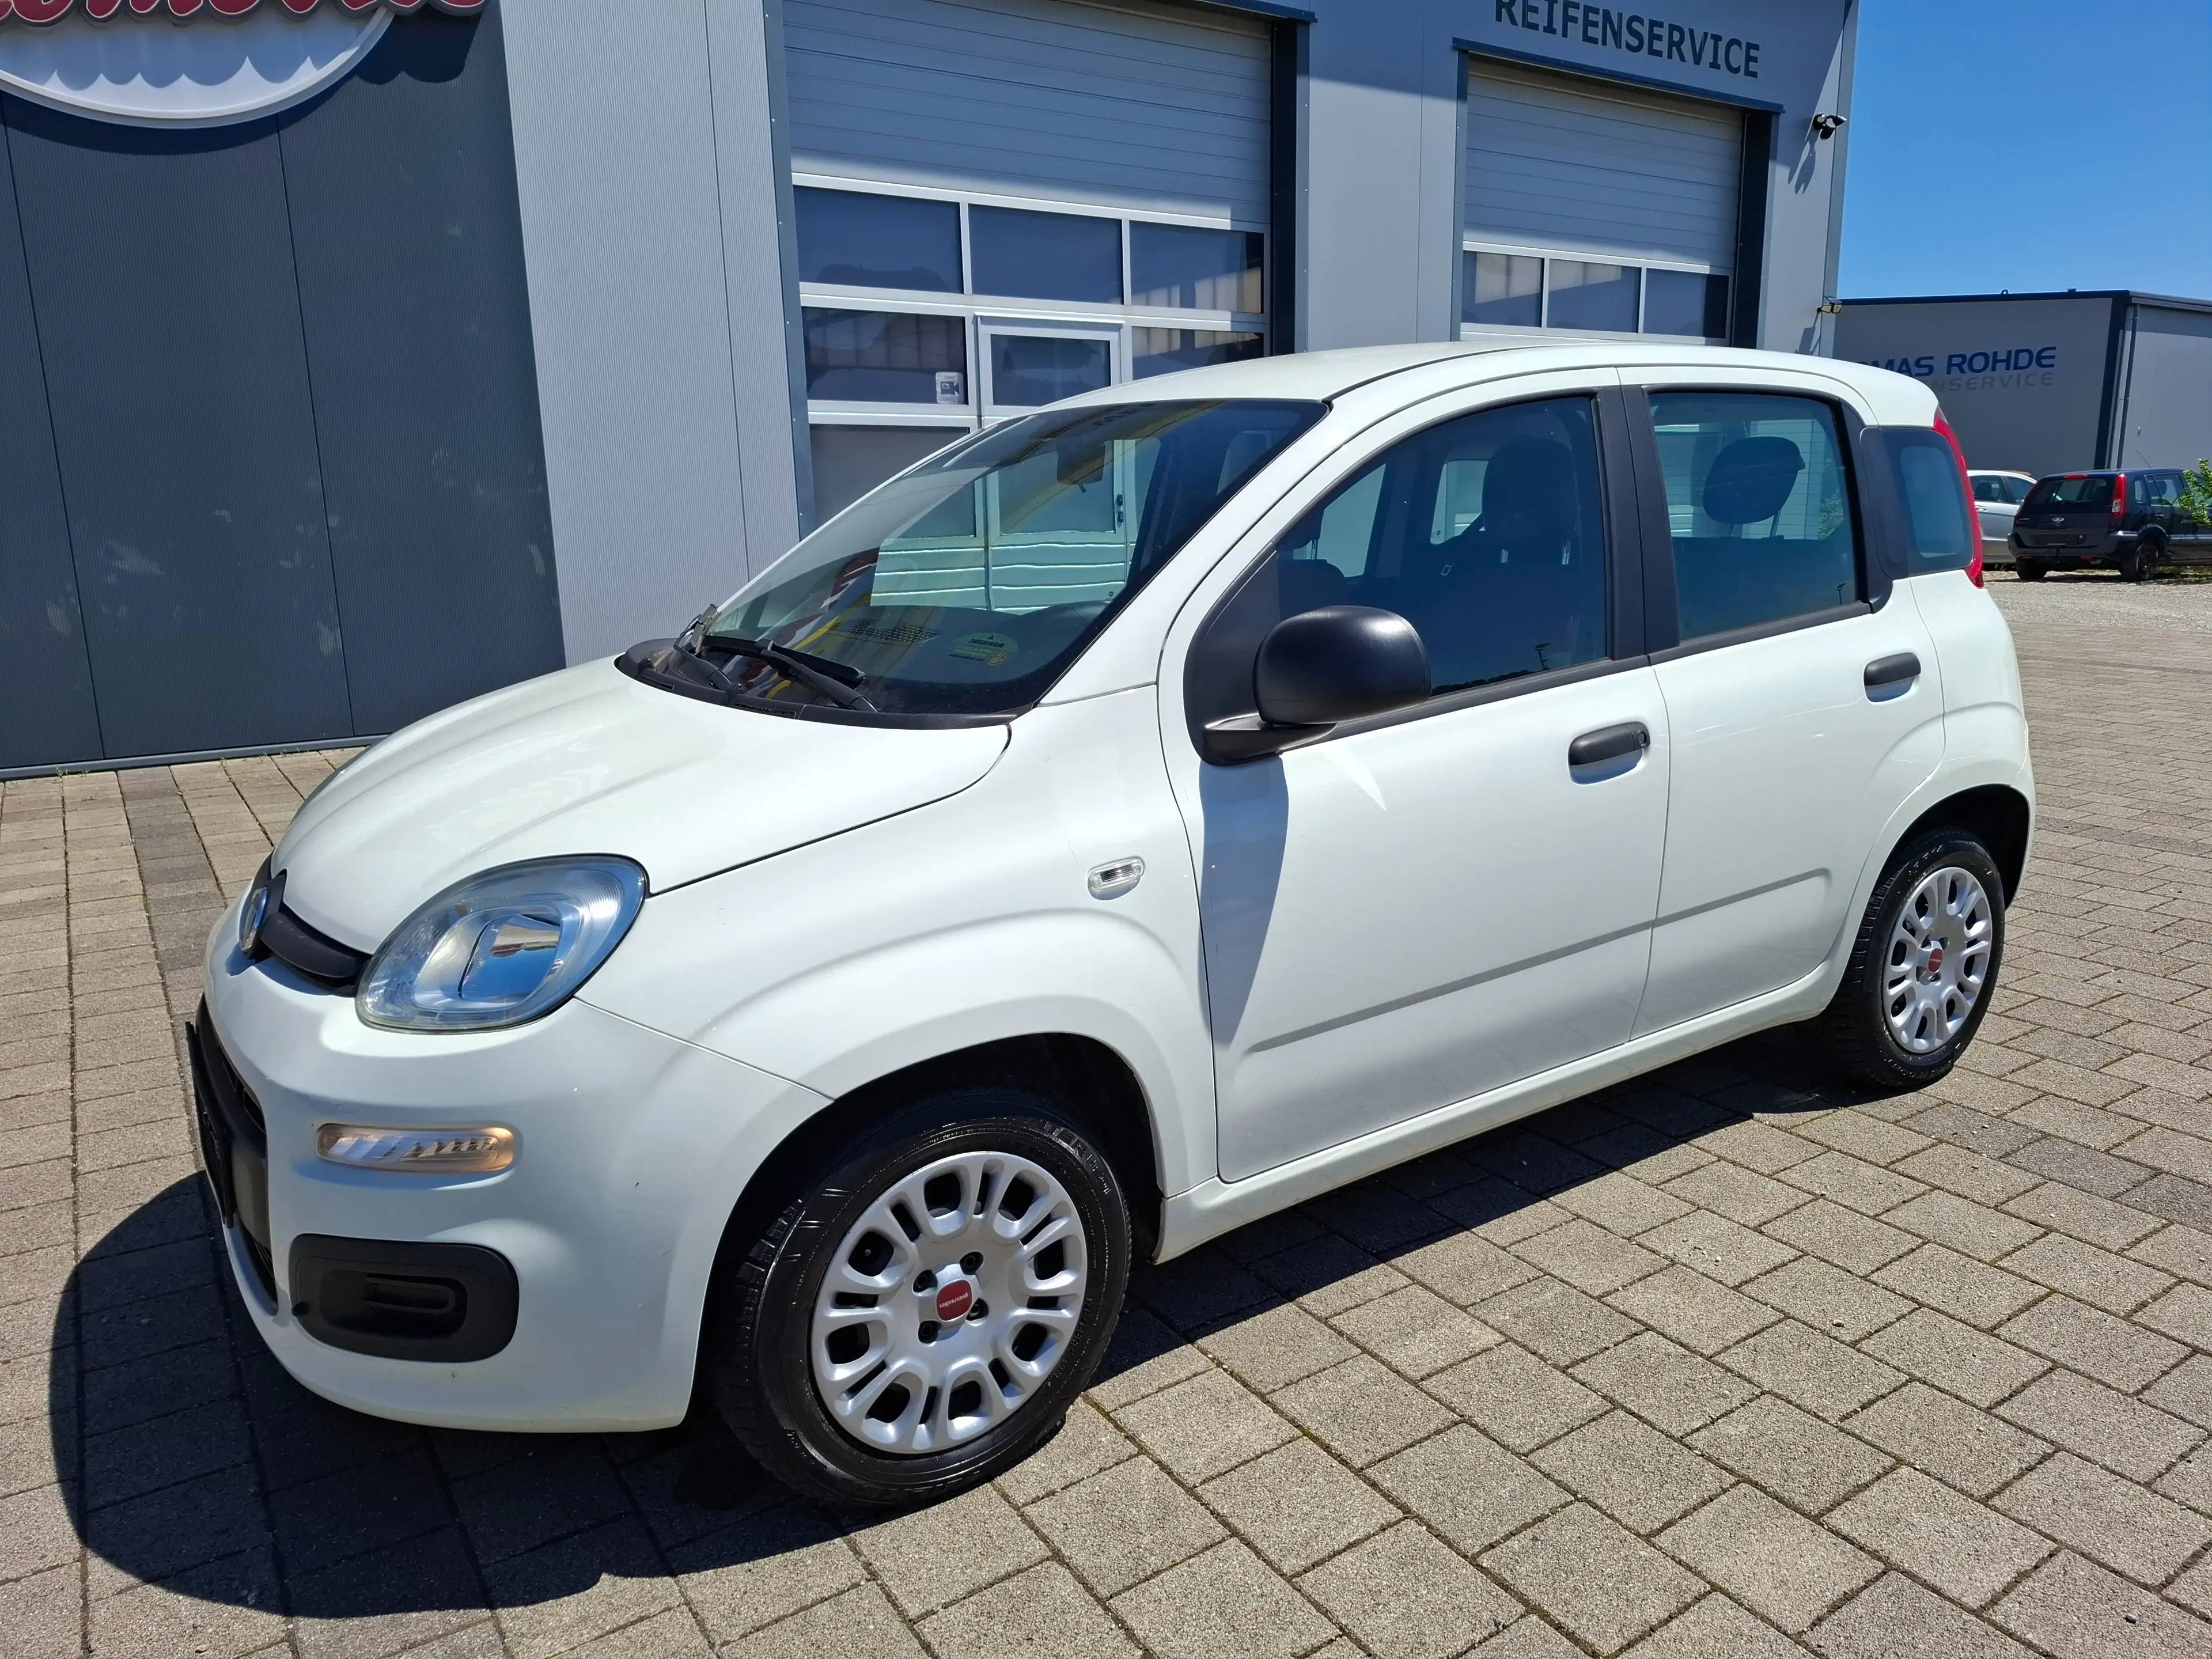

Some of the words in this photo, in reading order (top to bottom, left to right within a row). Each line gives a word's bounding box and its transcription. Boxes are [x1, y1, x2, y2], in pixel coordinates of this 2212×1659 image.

[1495, 0, 1760, 78] REIFENSERVICE
[1946, 346, 2057, 375] ROHDE
[1923, 372, 2054, 392] NSERVICE
[939, 1291, 969, 1308] panda
